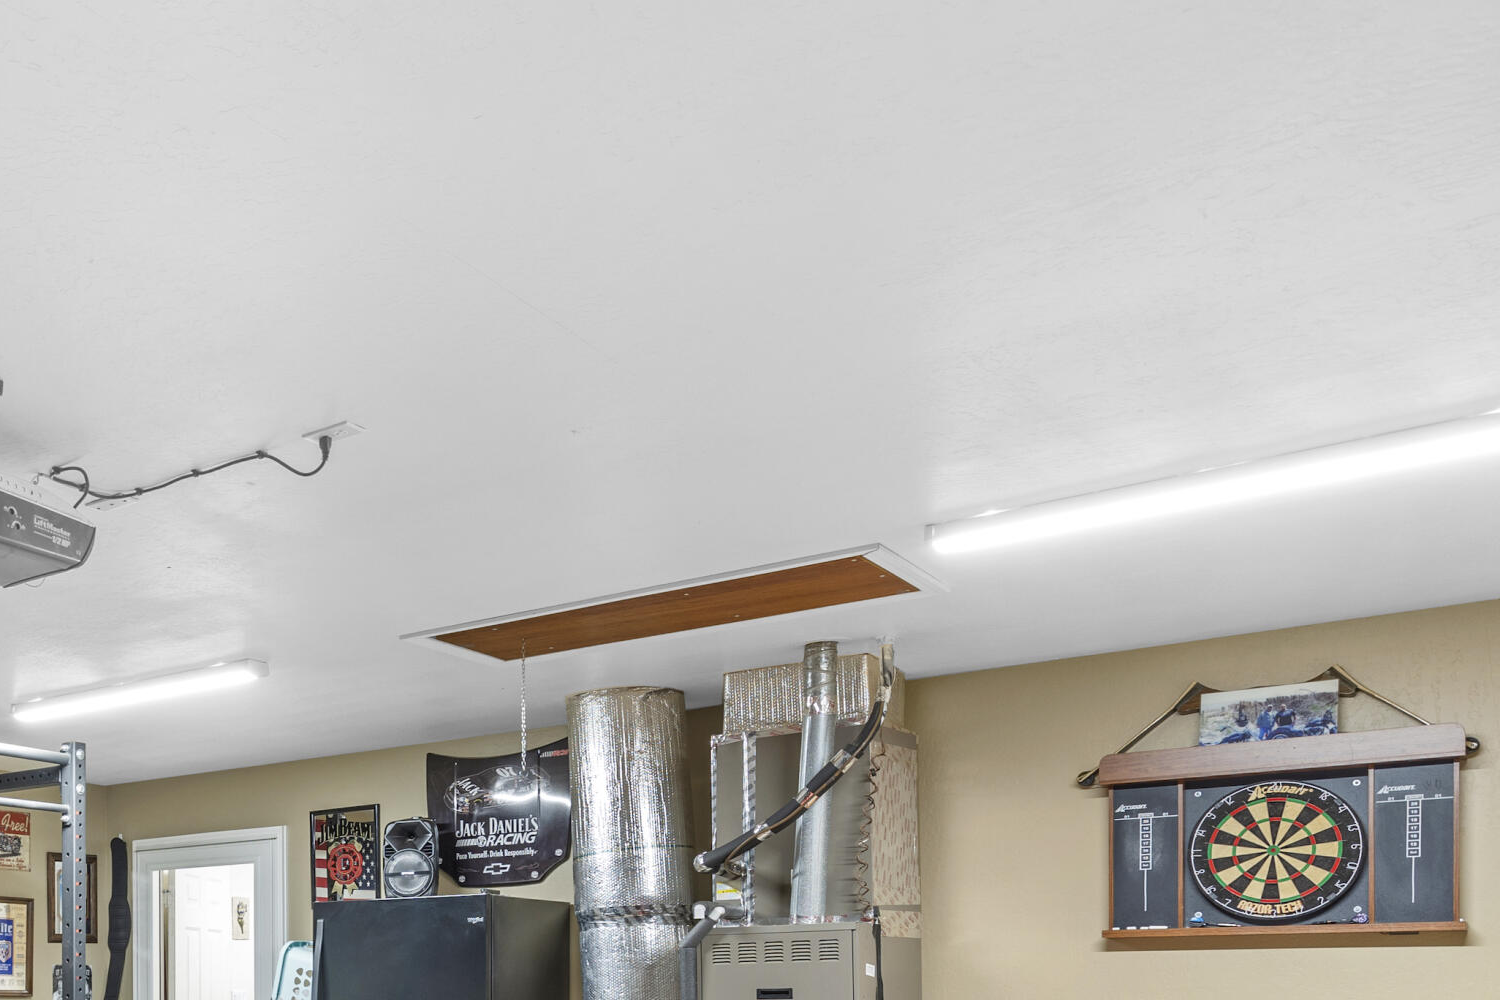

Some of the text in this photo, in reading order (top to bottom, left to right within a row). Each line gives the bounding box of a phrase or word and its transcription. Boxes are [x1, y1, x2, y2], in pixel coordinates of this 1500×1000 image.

[457, 777, 481, 796] JACK
[2, 813, 29, 832] Free!
[319, 817, 373, 845] JIM BEAM
[455, 814, 539, 838] JACK DANIEL'S
[486, 831, 537, 847] RACING
